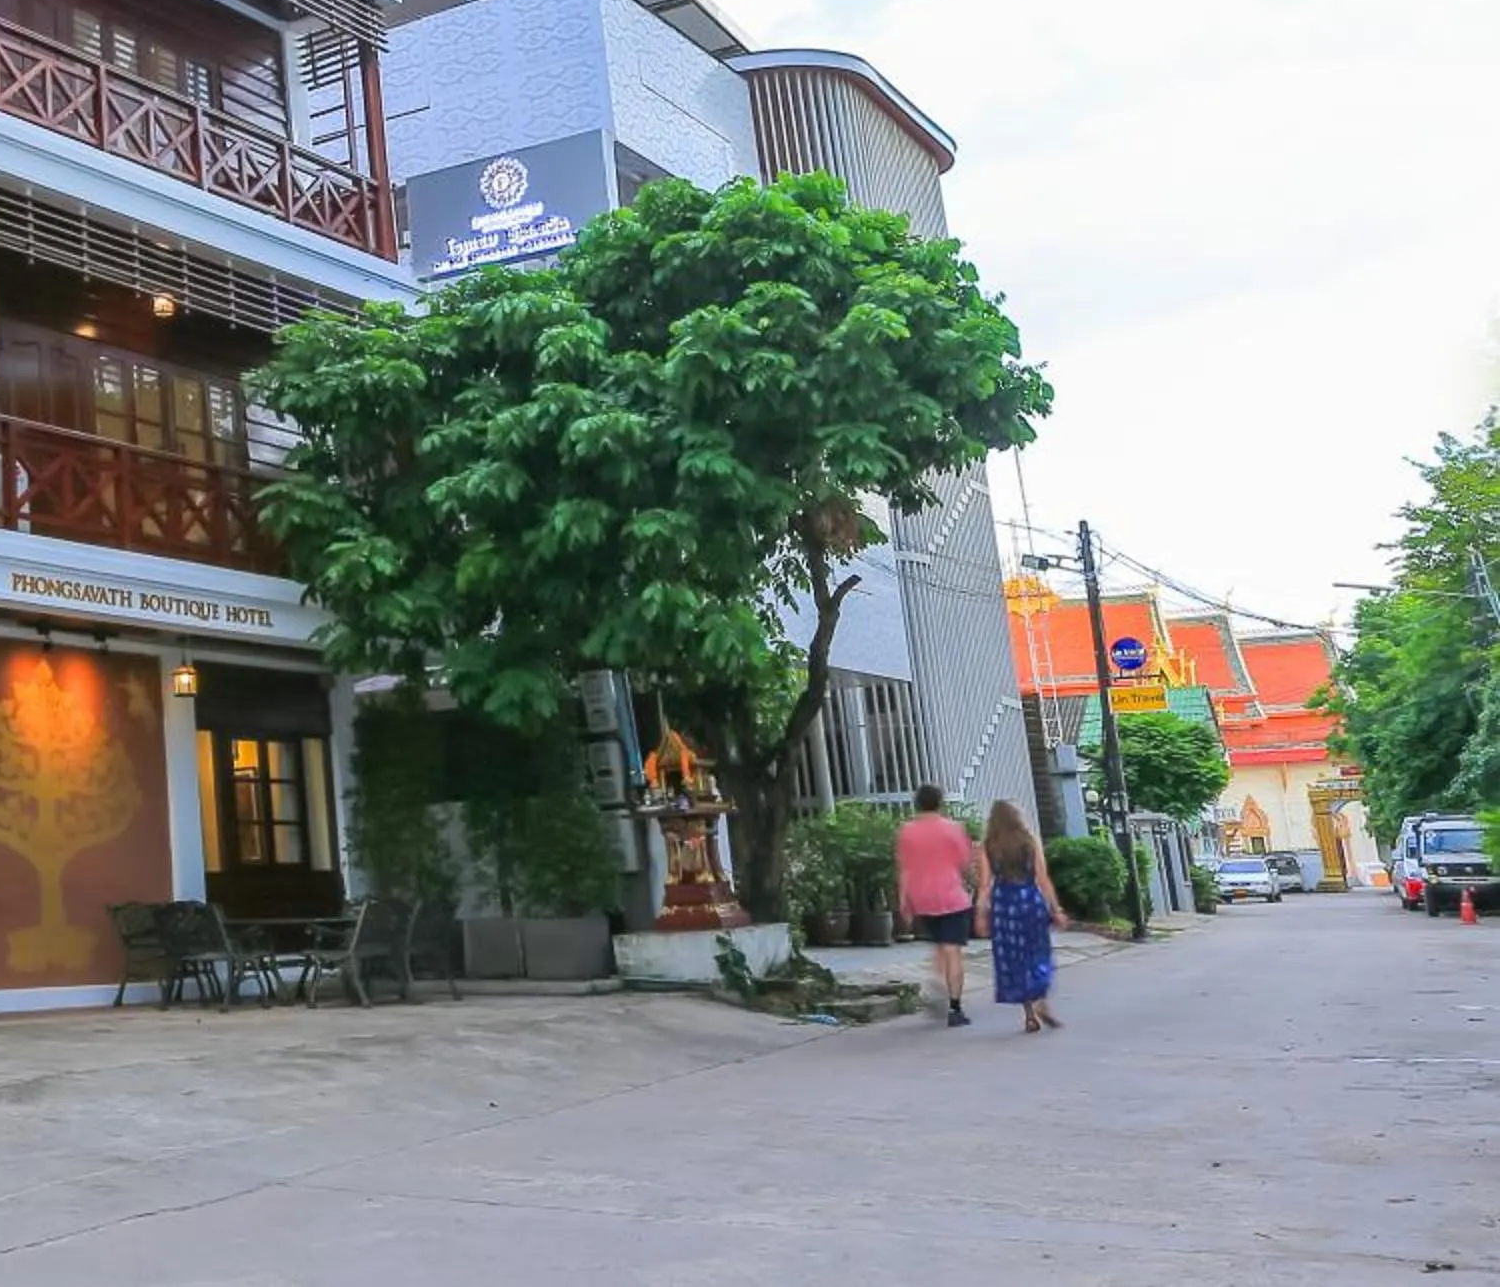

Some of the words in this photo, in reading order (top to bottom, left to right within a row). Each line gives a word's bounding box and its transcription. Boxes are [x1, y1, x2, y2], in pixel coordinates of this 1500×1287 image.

[11, 573, 133, 608] PHONGSAVATH
[139, 593, 220, 621] BOUTIQUE
[226, 606, 274, 628] HOTEL
